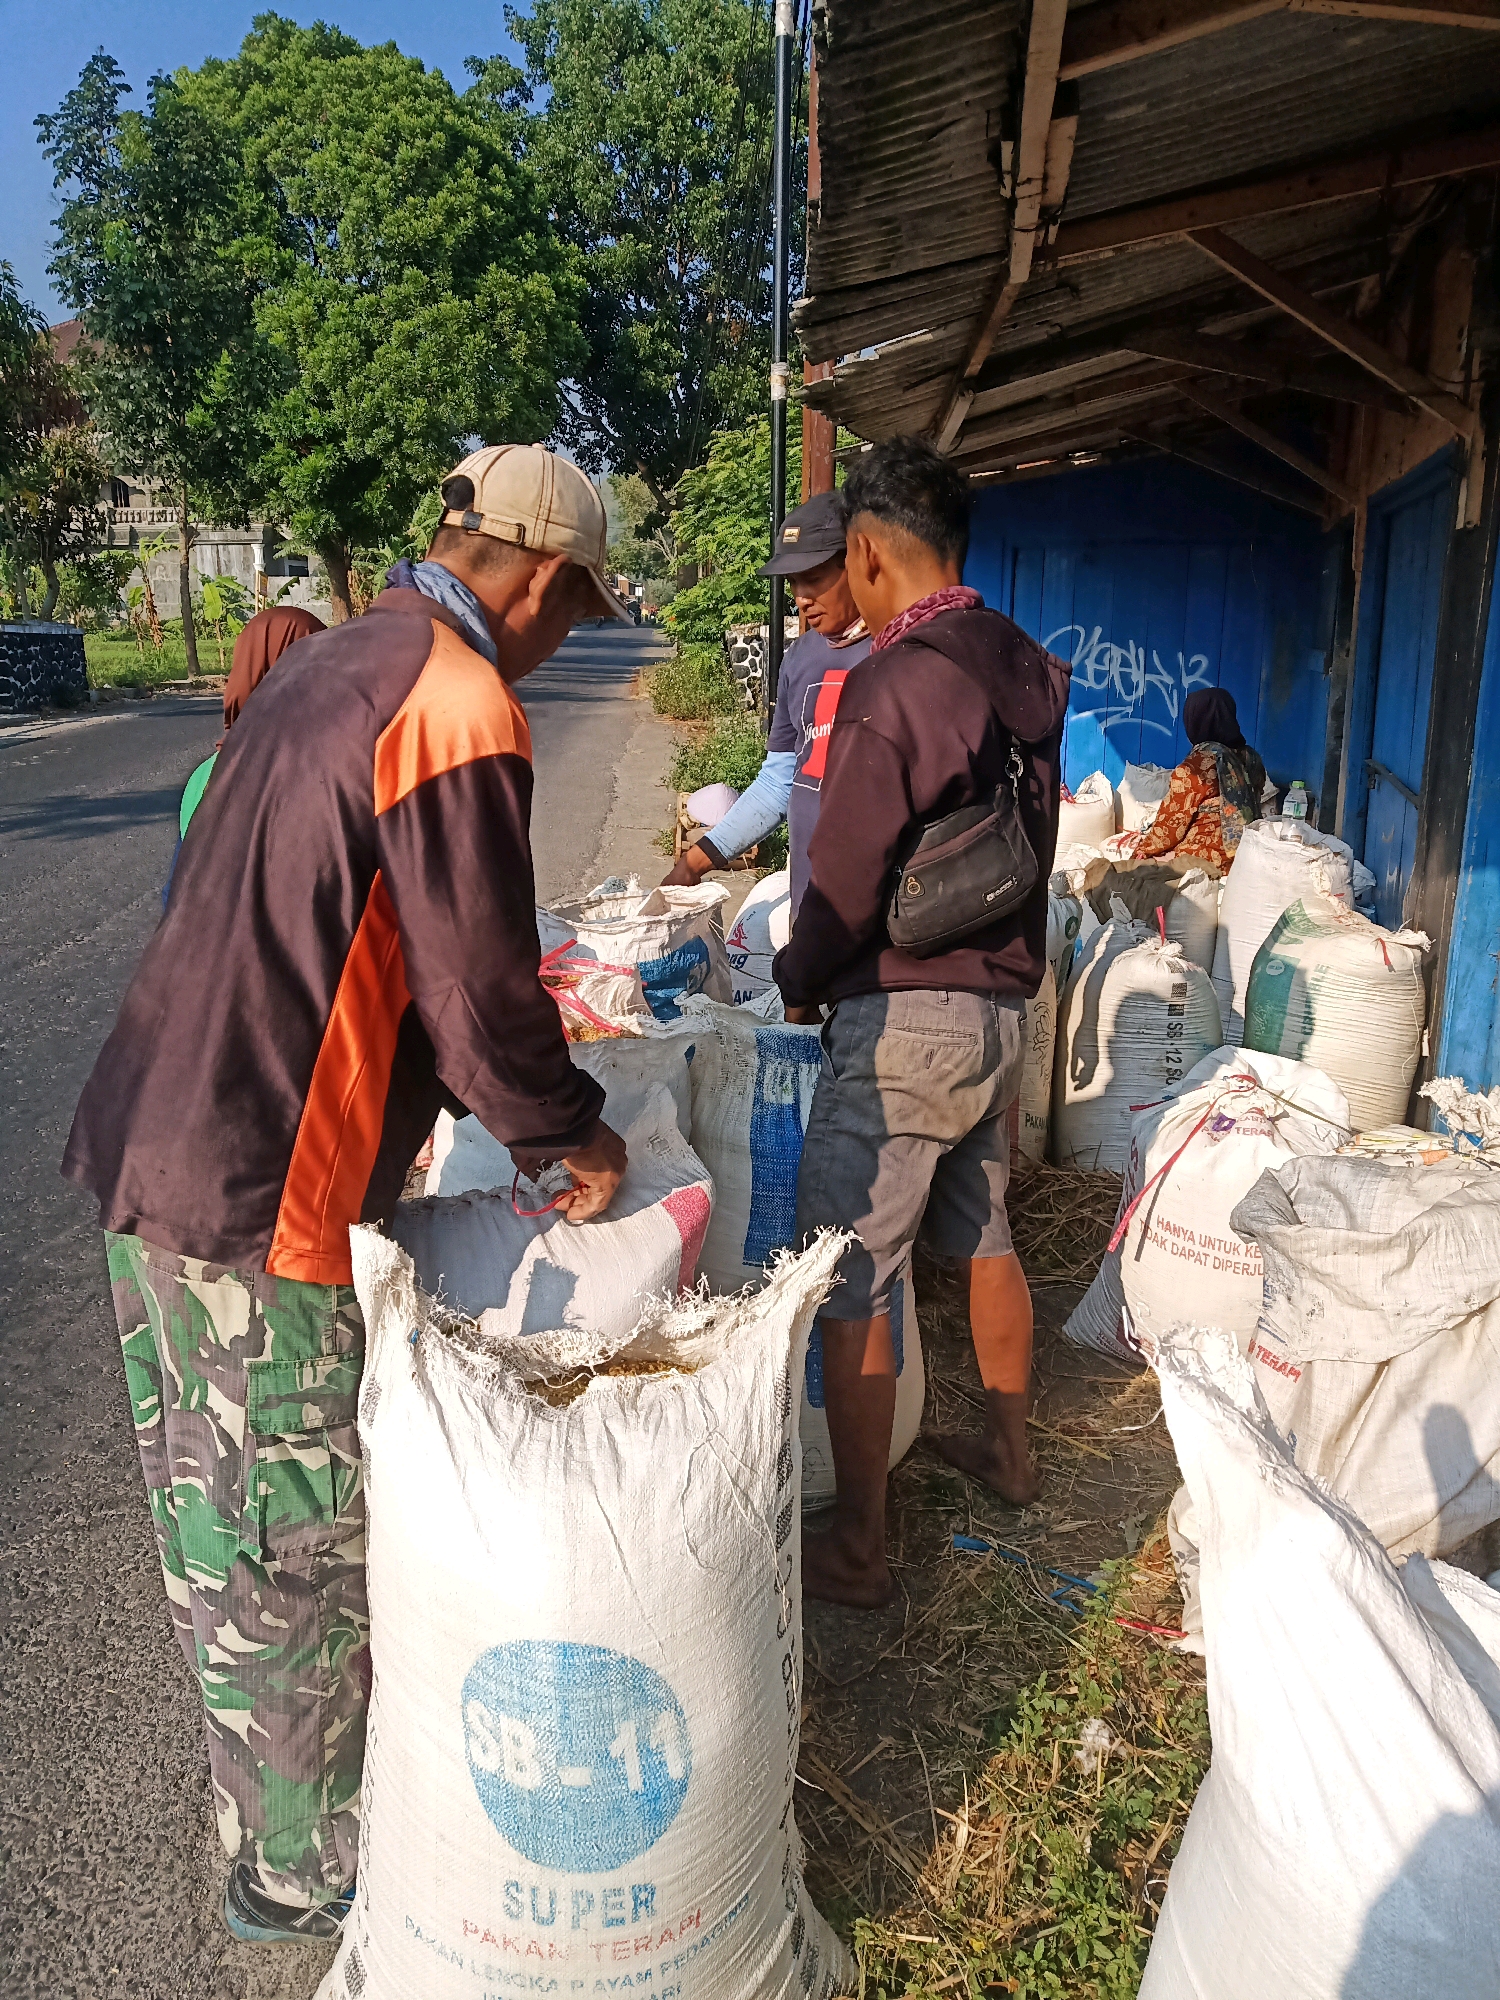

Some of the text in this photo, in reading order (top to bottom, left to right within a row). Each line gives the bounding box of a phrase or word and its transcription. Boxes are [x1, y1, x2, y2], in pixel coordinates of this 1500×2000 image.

[1157, 1215, 1195, 1245] HANYA
[1199, 1233, 1241, 1256] UNTUK
[1171, 1242, 1210, 1267] DAPAT
[502, 1879, 657, 1930] SUPER
[463, 1917, 569, 1961] PAKAN
